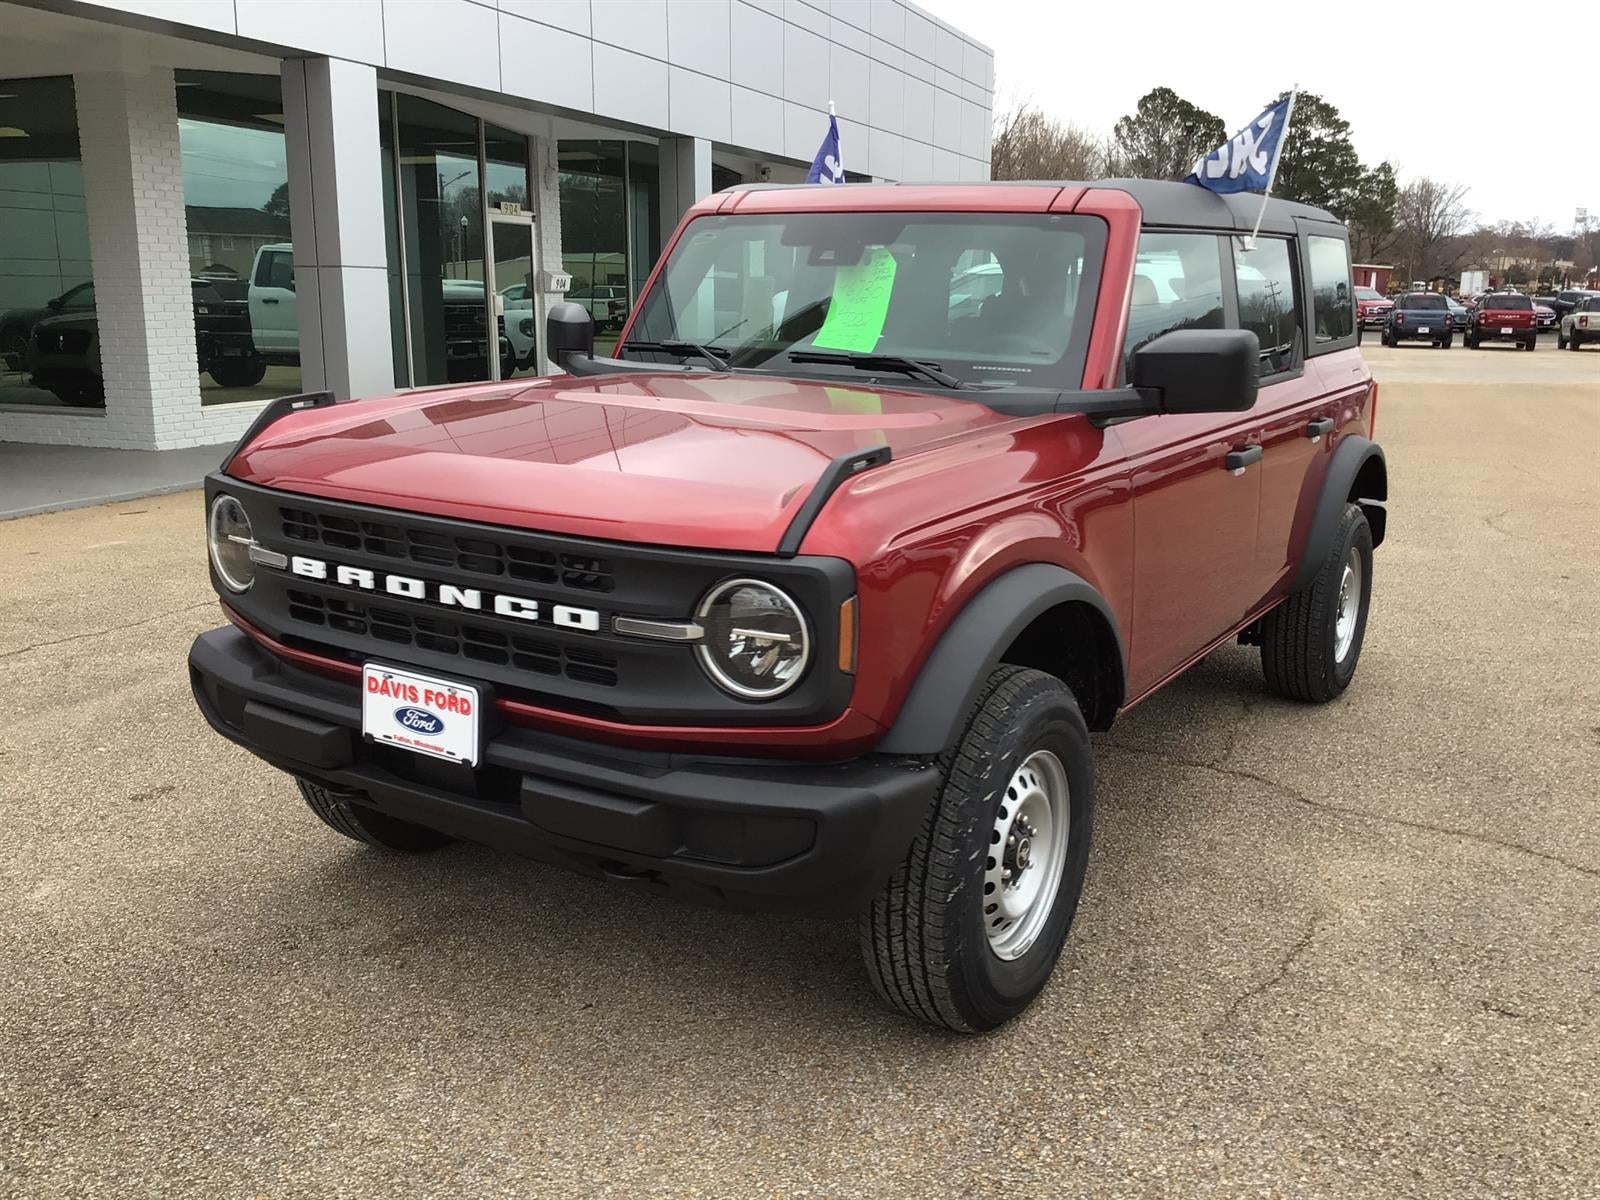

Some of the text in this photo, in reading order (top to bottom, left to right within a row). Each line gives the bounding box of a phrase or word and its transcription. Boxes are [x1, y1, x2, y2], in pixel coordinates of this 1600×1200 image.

[504, 203, 519, 214] 904
[555, 279, 567, 289] 904
[291, 556, 600, 631] BRONCO
[367, 675, 471, 716] DAVIS FORD
[403, 709, 436, 732] Ford
